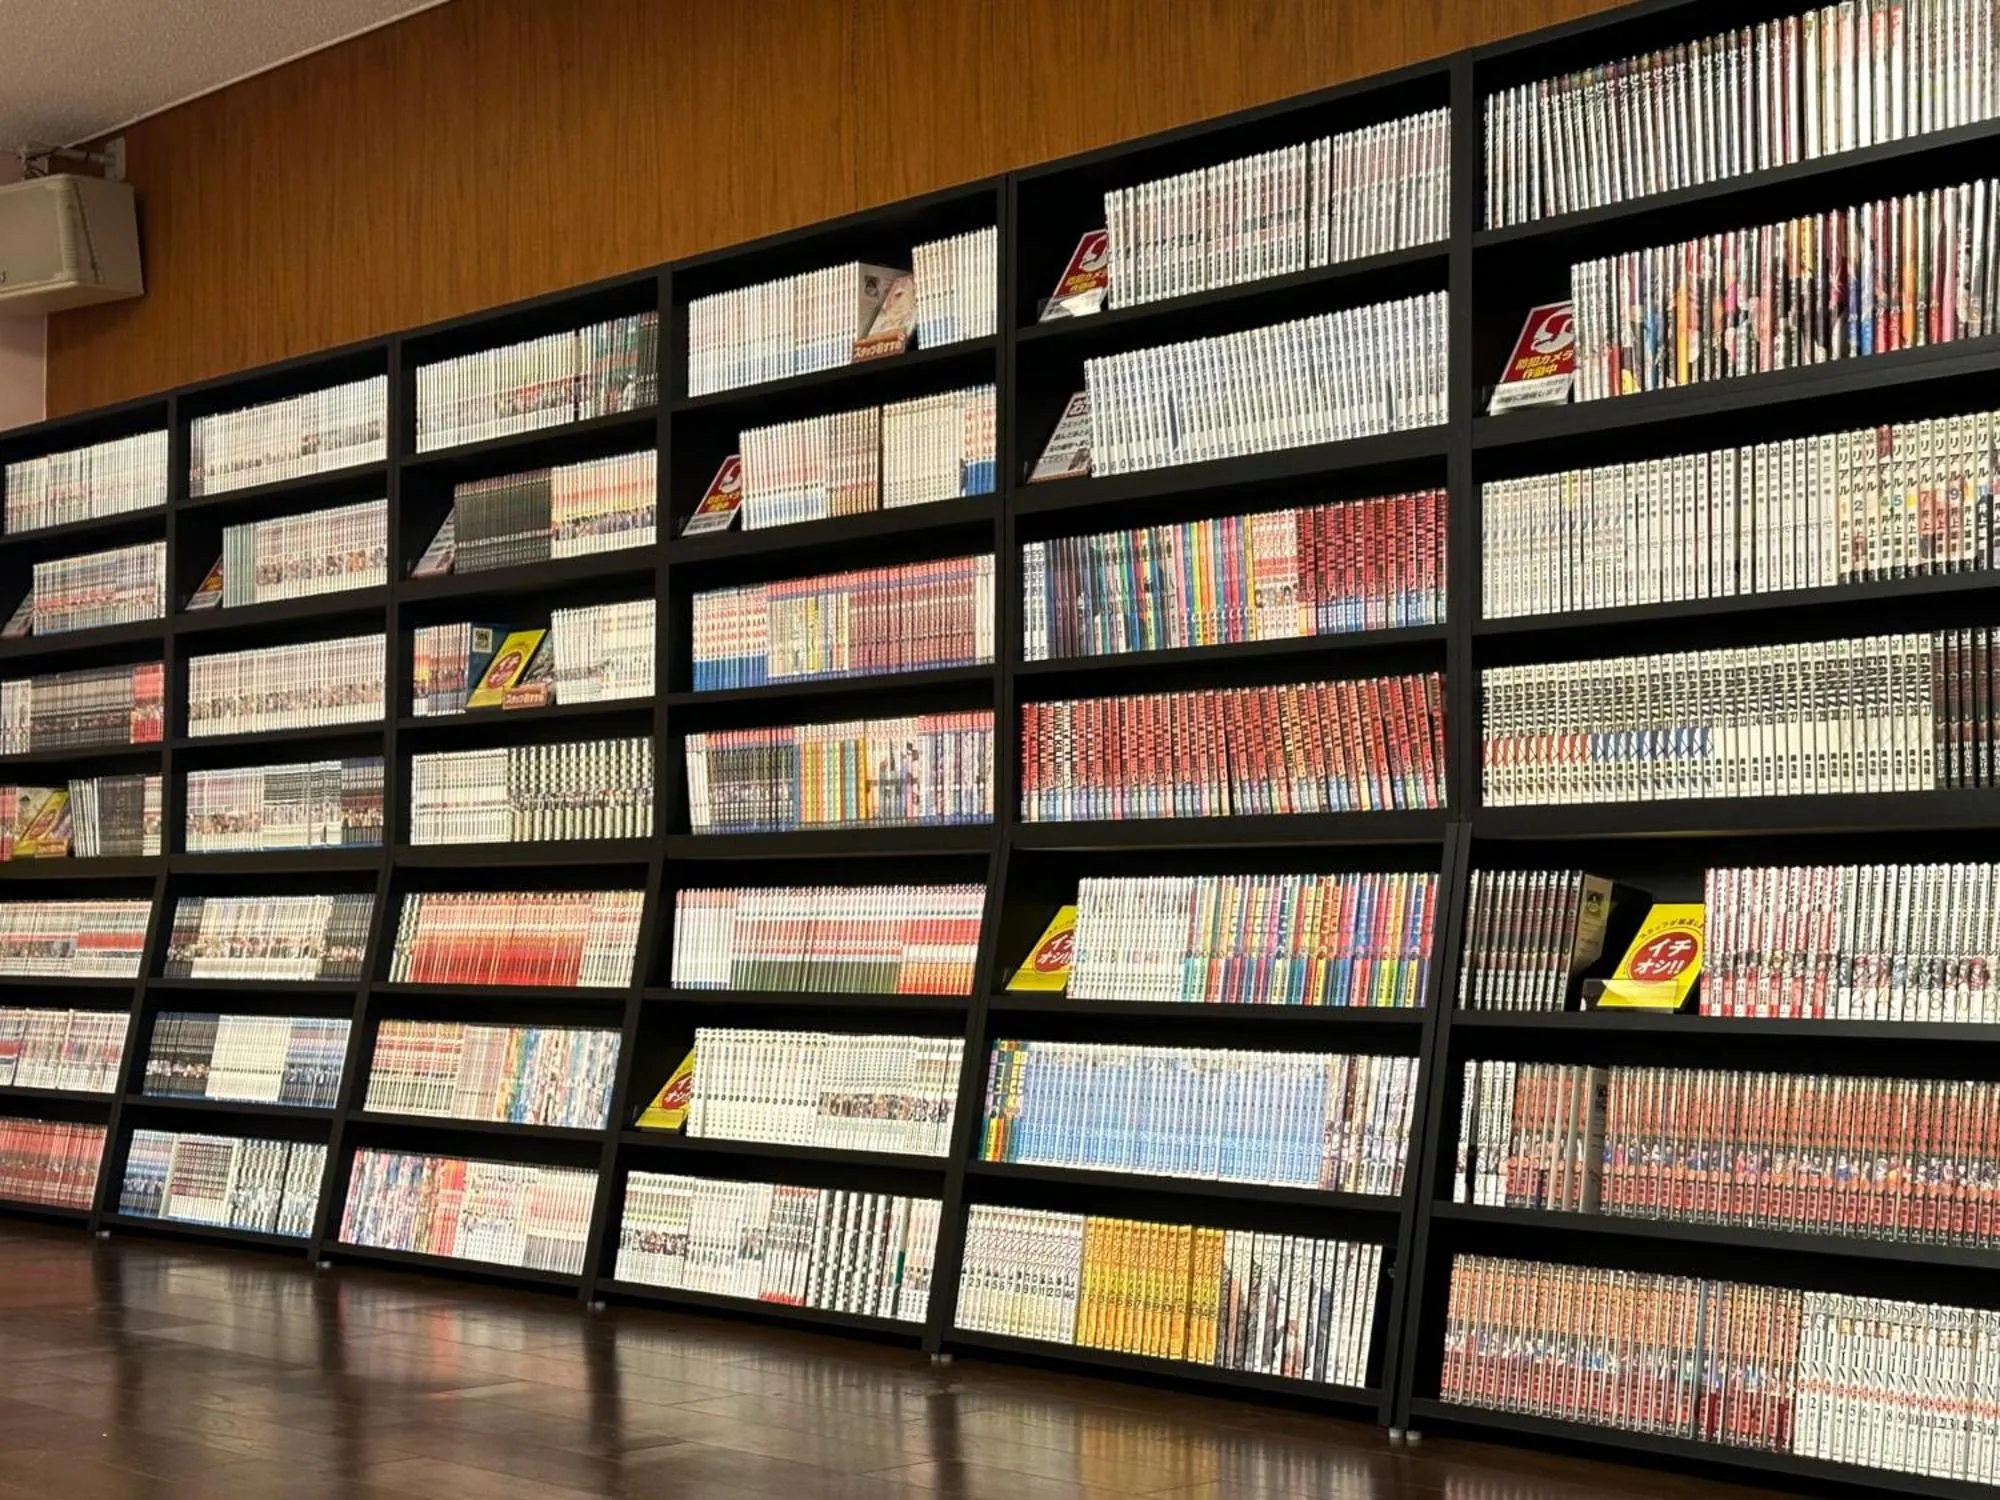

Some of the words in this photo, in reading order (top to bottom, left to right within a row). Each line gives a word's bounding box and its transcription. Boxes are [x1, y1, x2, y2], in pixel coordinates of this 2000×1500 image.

[1839, 454, 1850, 495] リアル
[1853, 452, 1864, 493] リアル
[1866, 449, 1877, 491] リアル
[1892, 445, 1903, 488] リアル
[1906, 445, 1917, 487] リアル
[1920, 441, 1931, 483] リアル
[1934, 439, 1946, 482] リアル
[1949, 437, 1962, 480] リアル
[1963, 436, 1974, 478] リアル
[1977, 432, 1989, 477] リアル
[1854, 500, 1863, 511] 2
[1894, 494, 1903, 505] 5
[1920, 491, 1930, 501] 7
[1950, 489, 1959, 500] 9
[1603, 677, 1613, 722] GANTZ
[1614, 676, 1624, 721] GANTZ
[1625, 675, 1635, 720] GANTZ
[1638, 674, 1648, 719] GANTZ
[1650, 674, 1660, 718] GANTZ
[1663, 673, 1673, 717] GANTZ
[1676, 672, 1686, 716] GANTZ
[1688, 671, 1698, 716] GANTZ
[1701, 670, 1711, 715] GANTZ
[1712, 669, 1722, 715] GANTZ
[1724, 668, 1735, 714] GANTZ
[1737, 667, 1746, 714] GANTZ
[1749, 666, 1759, 713] GANTZ
[1761, 665, 1772, 711] GANTZ
[1774, 663, 1785, 709] GANTZ
[1787, 662, 1798, 710] GANTZ
[1801, 662, 1812, 709] GANTZ
[1814, 661, 1825, 709] GANTZ
[1827, 660, 1837, 707] GANTZ
[1839, 659, 1849, 706] GANTZ
[1853, 657, 1864, 706] GANTZ
[1866, 656, 1877, 705] GANTZ
[1879, 655, 1890, 704] GANTZ
[1891, 654, 1903, 703] GANTZ
[1905, 654, 1916, 703] GANTZ
[1920, 653, 1930, 702] GANTZ
[1493, 685, 1502, 728] GANTZ
[1504, 685, 1512, 728] GANTZ
[1514, 683, 1523, 727] GANTZ
[1525, 682, 1534, 726] GANTZ
[1536, 682, 1545, 725] GANTZ
[1547, 680, 1556, 724] GANTZ
[1558, 681, 1568, 724] GANTZ
[1570, 680, 1578, 723] GANTZ
[1581, 679, 1590, 722] GANTZ
[1592, 678, 1602, 722] GANTZ
[1633, 958, 1685, 975] オシ!!
[1649, 938, 1692, 957] イチ
[1799, 1398, 1803, 1409] 1
[1810, 1398, 1816, 1409] 2
[1823, 1400, 1830, 1411] 3
[1836, 1403, 1843, 1414] 4
[1849, 1404, 1856, 1416] 5
[1861, 1407, 1868, 1418] 6
[1874, 1408, 1881, 1418] 7
[1886, 1411, 1893, 1422] 8
[1897, 1412, 1905, 1422] 9
